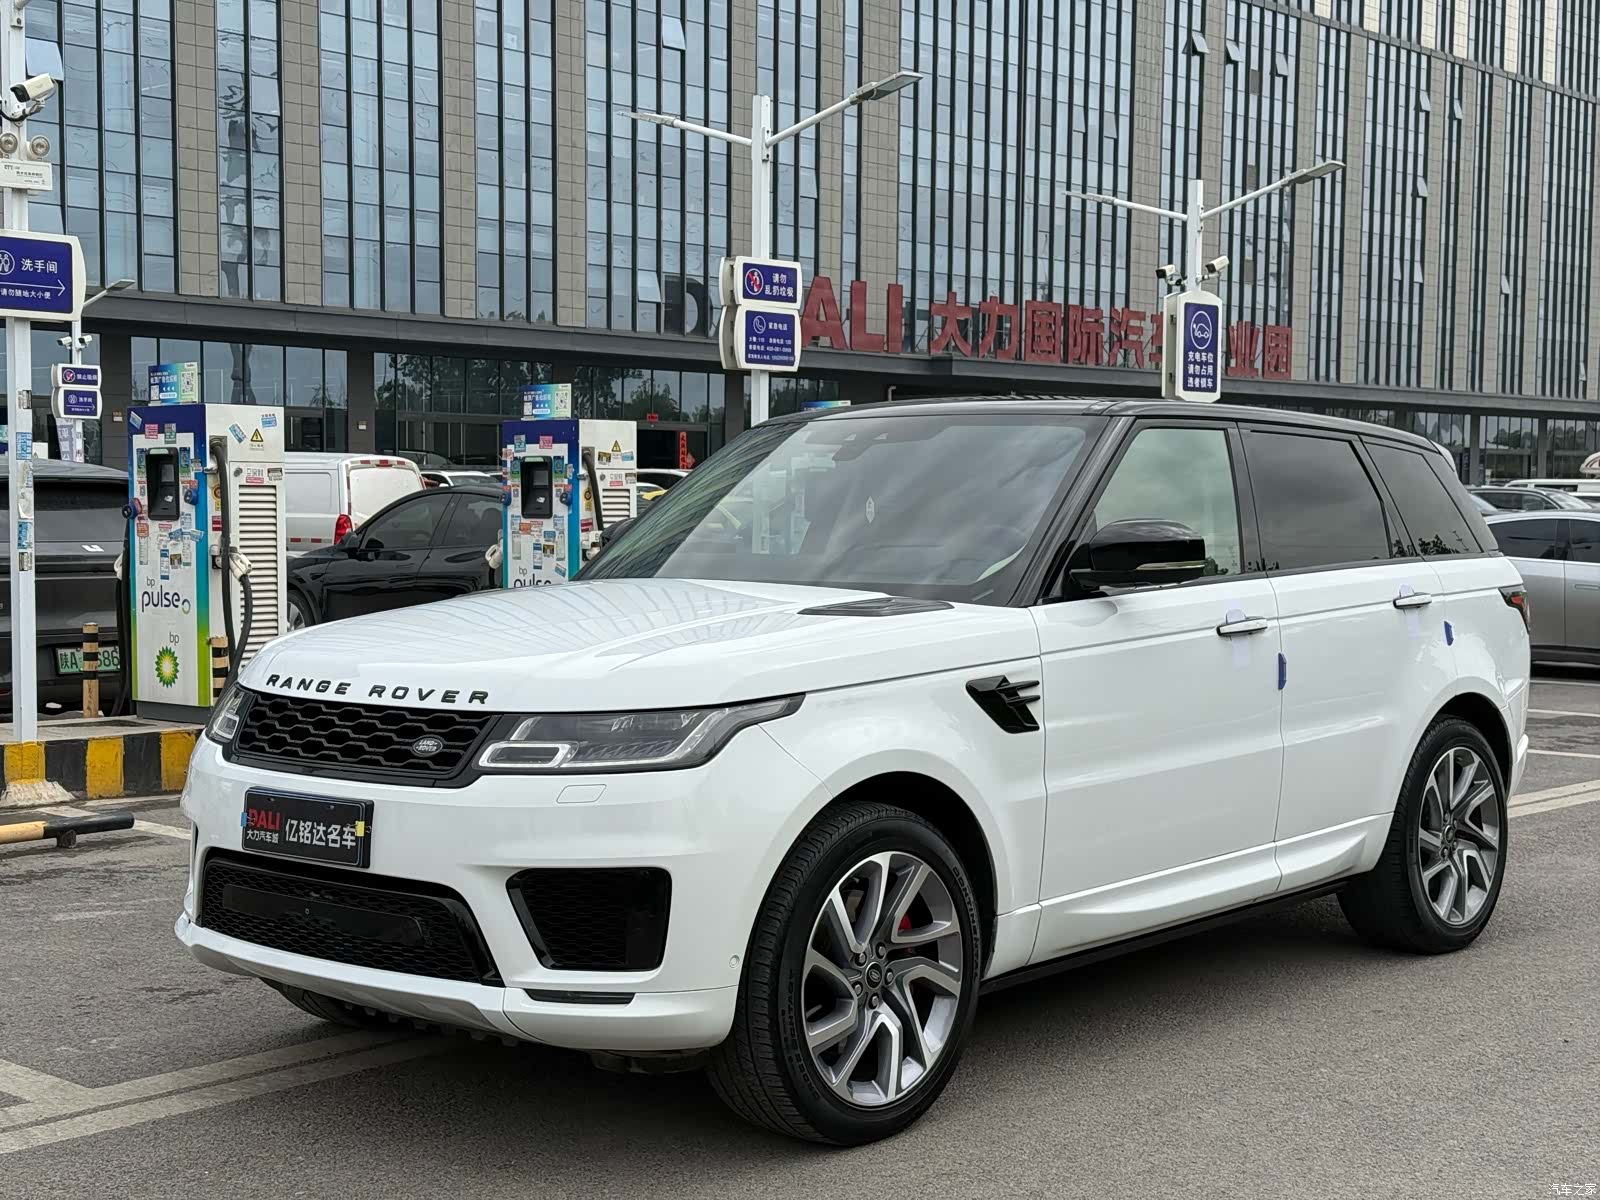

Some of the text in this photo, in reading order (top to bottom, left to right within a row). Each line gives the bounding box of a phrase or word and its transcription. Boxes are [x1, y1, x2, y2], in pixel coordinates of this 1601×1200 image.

[20, 257, 58, 274] 洗手间
[771, 272, 788, 284] 请勿
[0, 287, 51, 300] 请勿随地大小便
[764, 284, 794, 297] 乱扔垃圾
[1187, 350, 1214, 363] 充电车位
[1187, 363, 1214, 376] 请勿占用
[146, 576, 156, 589] bp
[141, 585, 181, 613] pulse
[169, 632, 180, 646] bp
[265, 673, 490, 705] RANGE ROVER
[247, 807, 281, 831] DALI
[246, 829, 279, 844] 大力汽车城
[285, 818, 357, 850] 亿铭达名车
